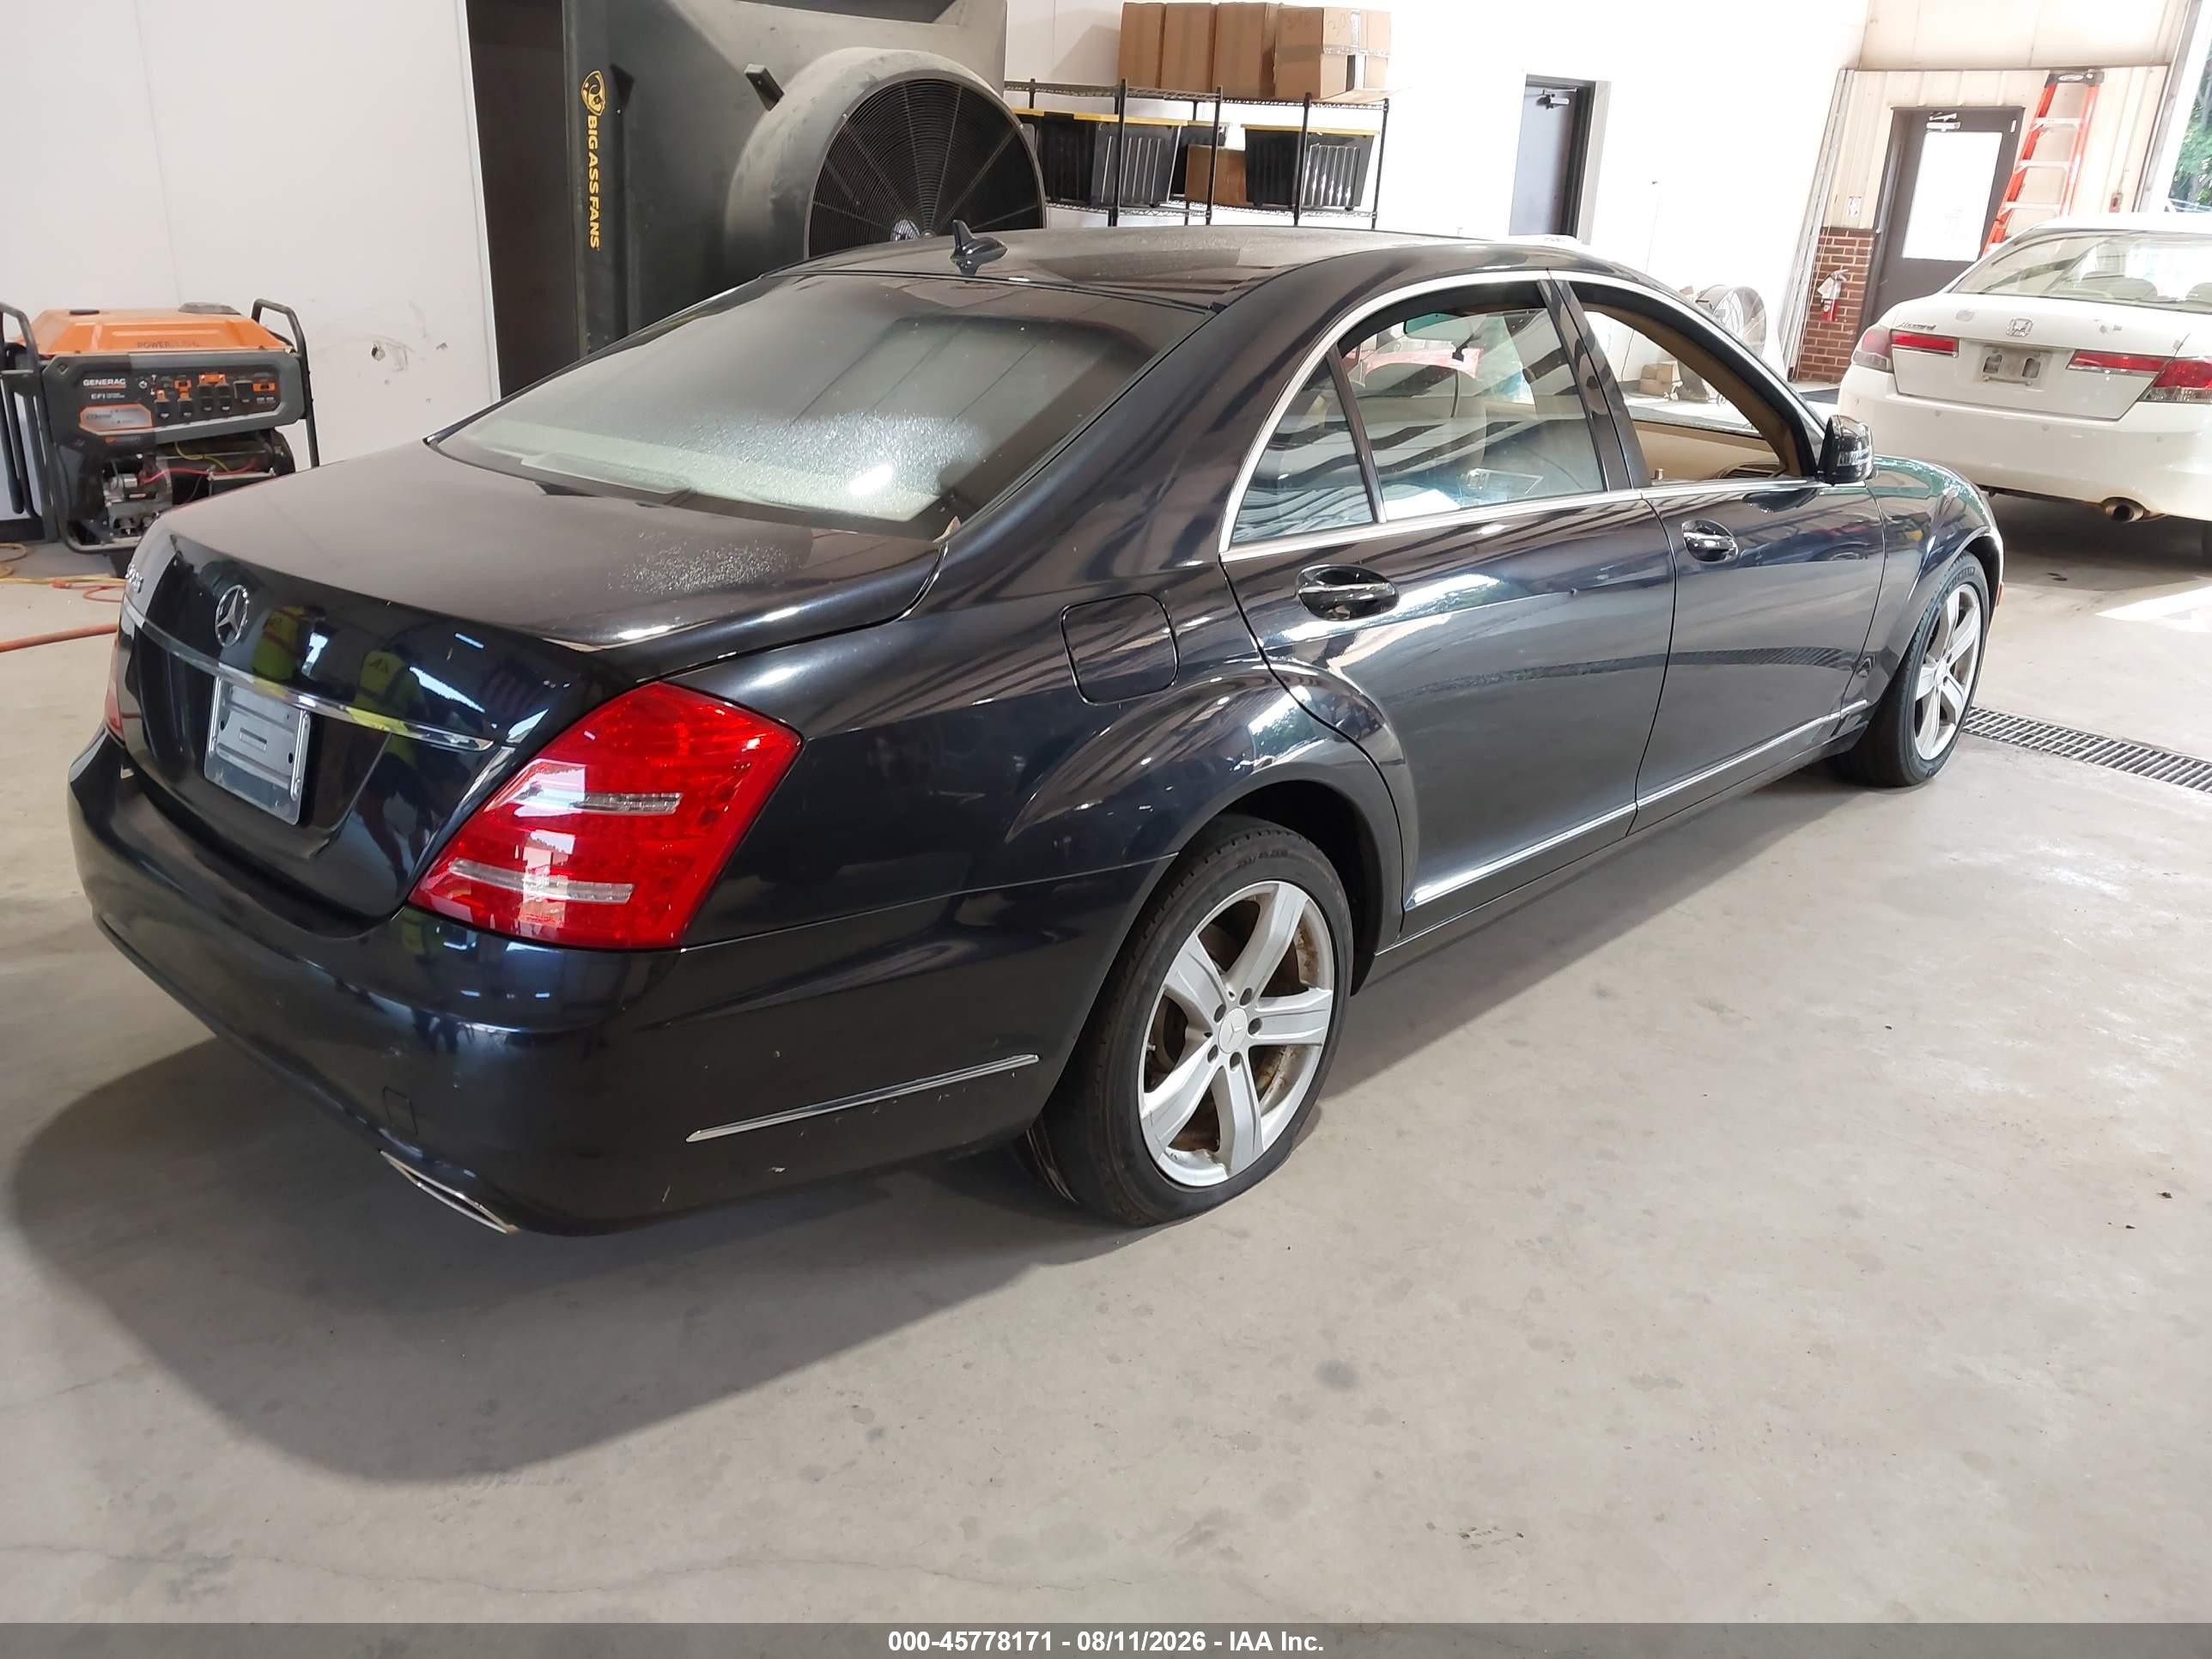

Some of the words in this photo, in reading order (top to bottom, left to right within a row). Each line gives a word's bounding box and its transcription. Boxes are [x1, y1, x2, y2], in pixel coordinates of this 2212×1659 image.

[587, 114, 598, 149] BIG
[588, 151, 599, 194] ASS
[589, 196, 599, 248] FANS
[82, 378, 126, 386] GENERAC
